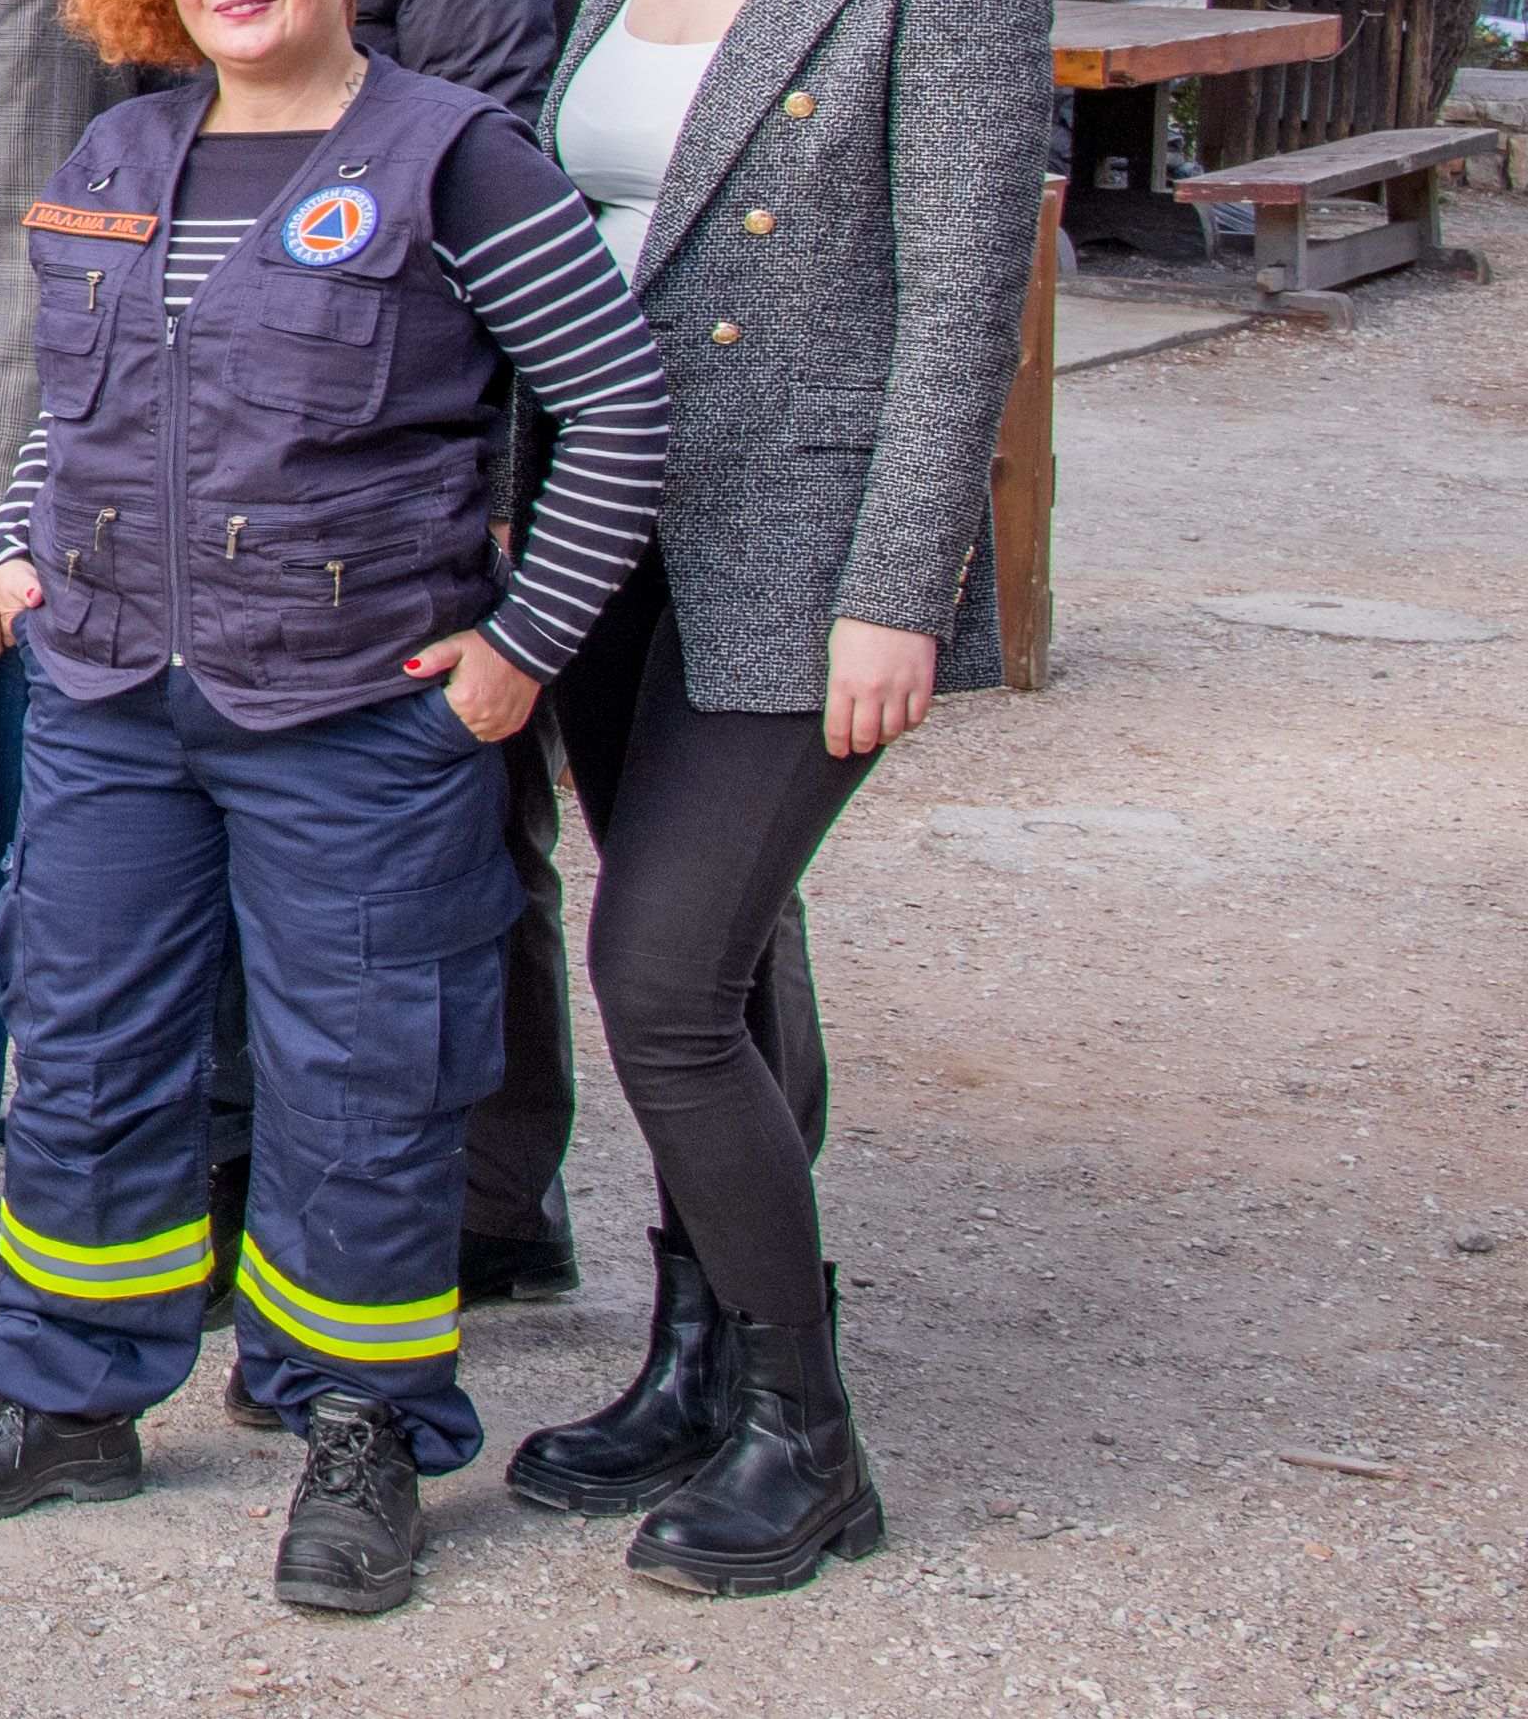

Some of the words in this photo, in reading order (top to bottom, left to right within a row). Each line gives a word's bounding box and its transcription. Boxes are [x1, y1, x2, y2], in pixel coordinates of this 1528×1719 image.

[288, 189, 339, 229] ΠΟΛΙΤΙΚΗ
[341, 189, 374, 237] ΠΡΟΣΤΑΣΙΑ
[288, 238, 353, 262] ΕΛΛΑΔΑ
